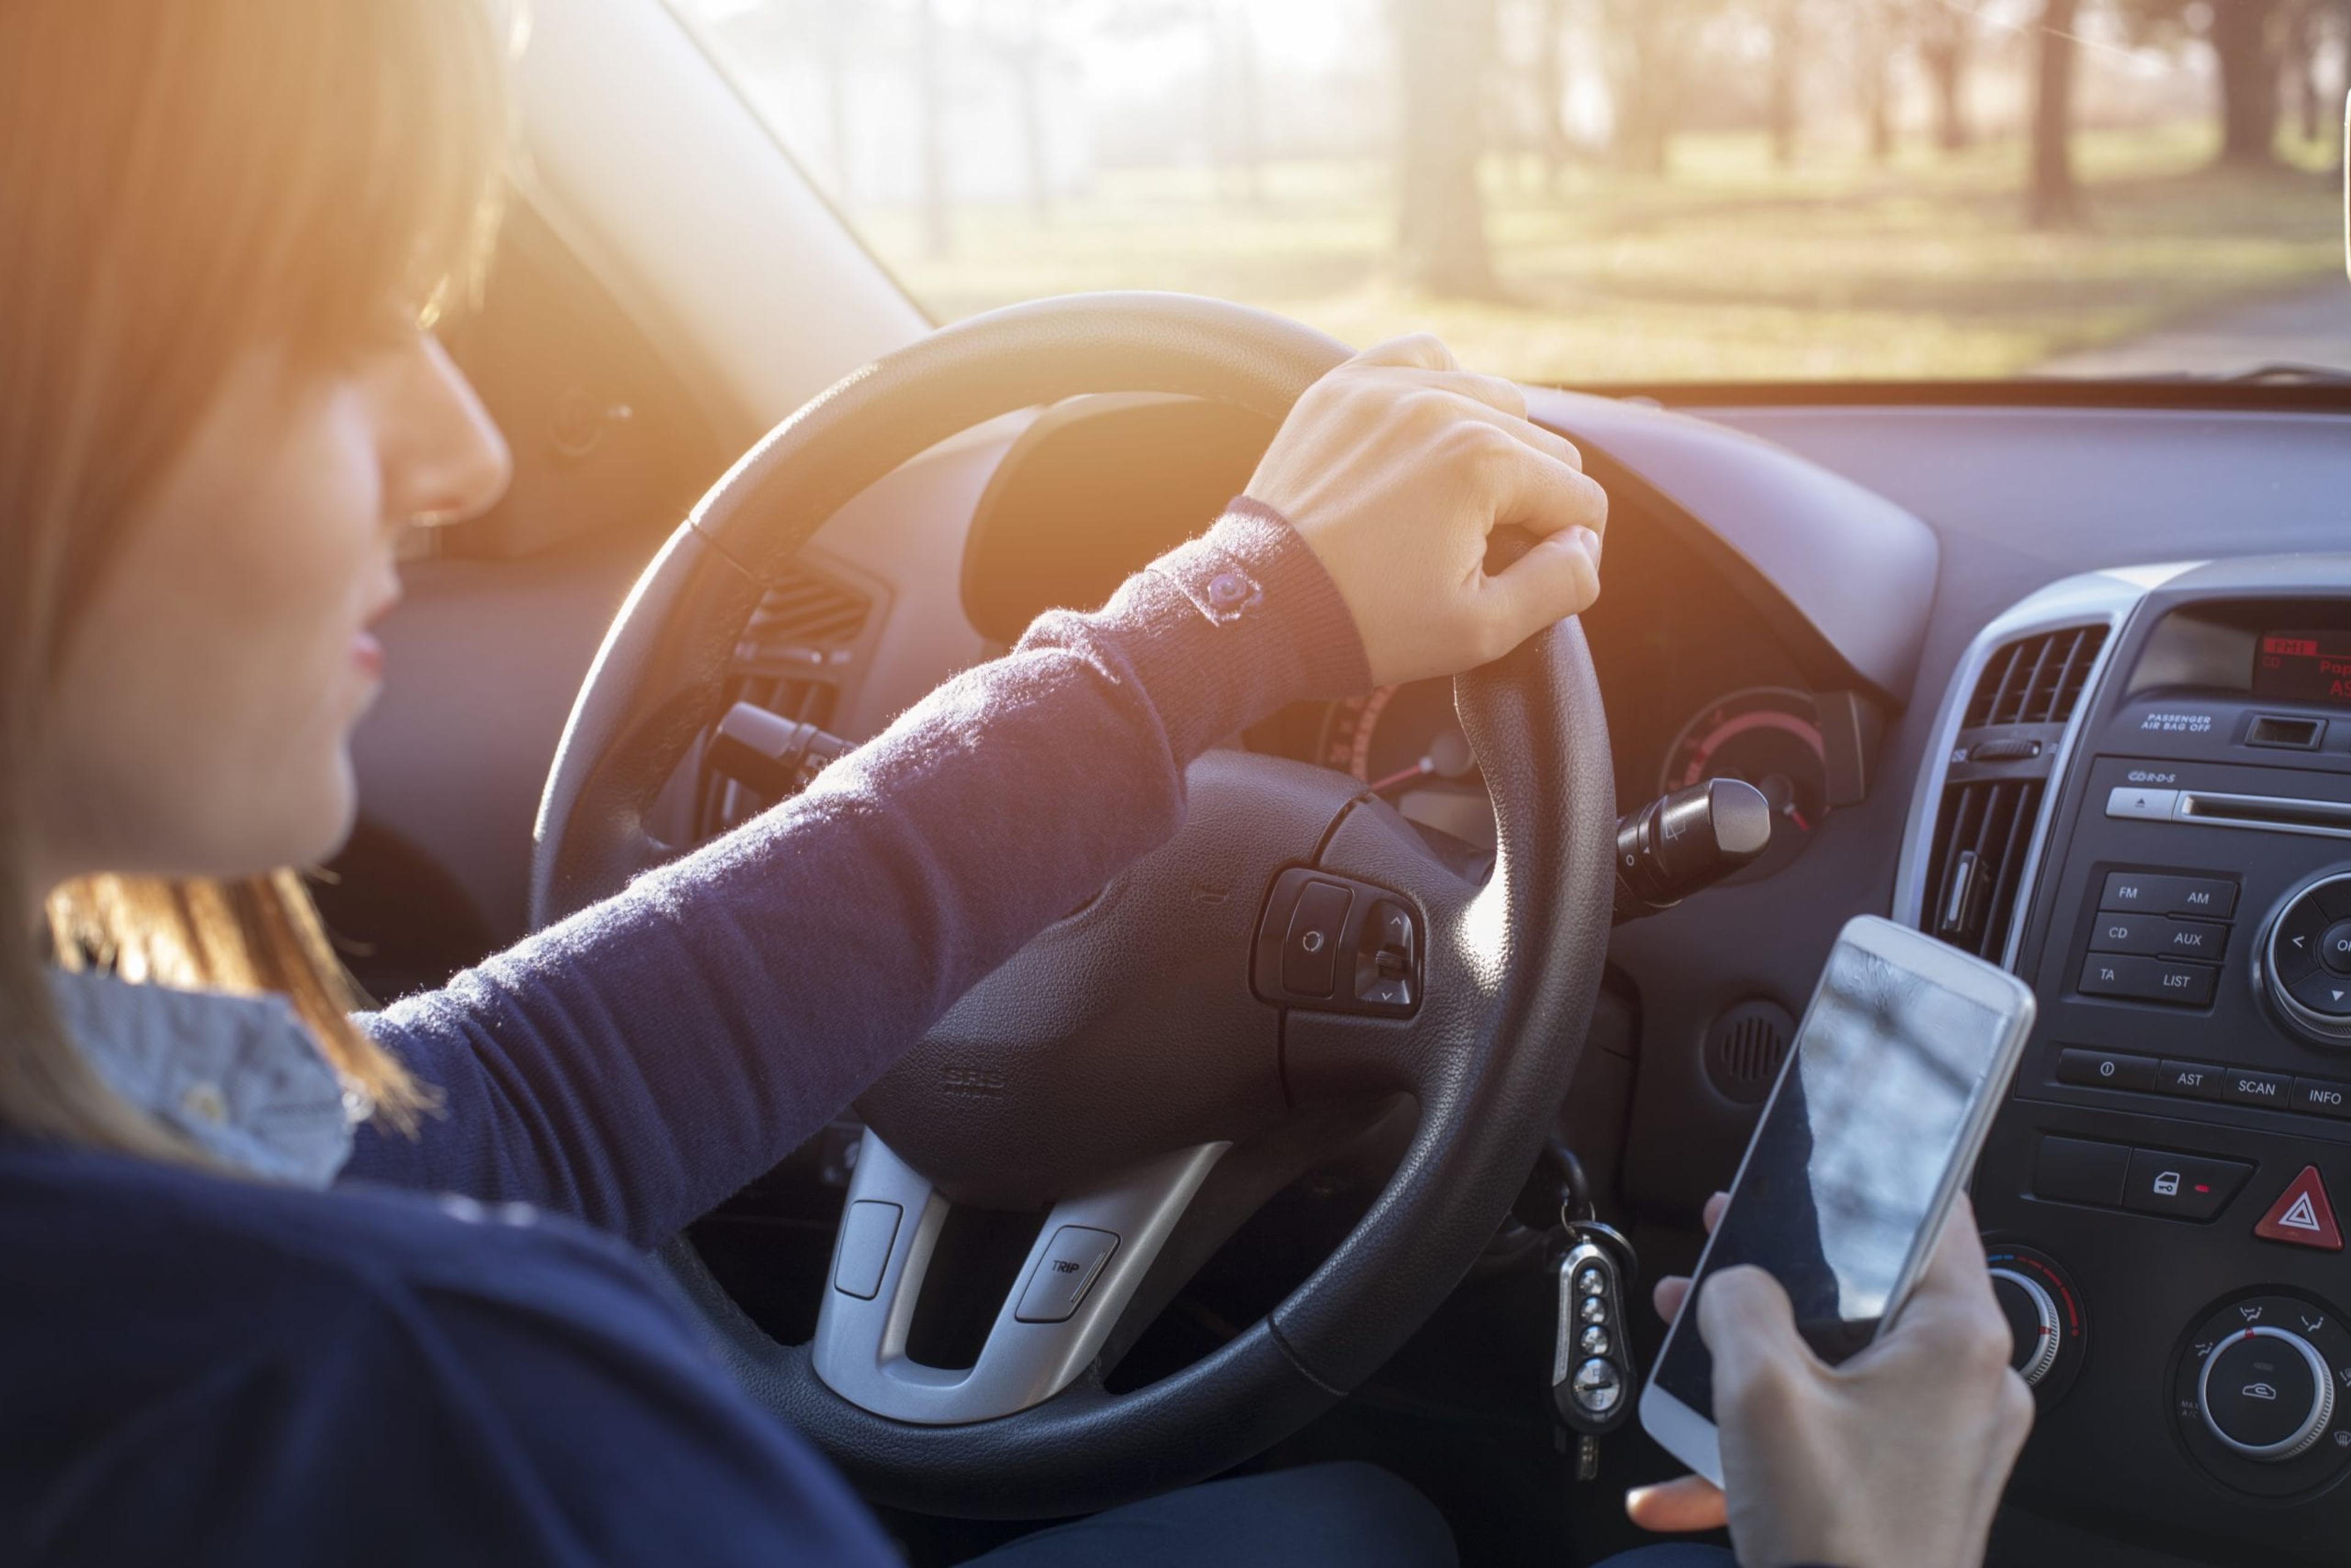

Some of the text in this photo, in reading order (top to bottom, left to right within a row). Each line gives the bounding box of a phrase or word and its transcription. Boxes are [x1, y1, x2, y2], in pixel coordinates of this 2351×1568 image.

[2141, 721, 2211, 732] AIR BAG OFF
[2147, 713, 2211, 724] PASSENGER
[2118, 887, 2210, 905] FM AM
[2108, 926, 2203, 946] CD AUX
[2101, 968, 2191, 988] TA LIST
[2177, 1072, 2342, 1105] AST SCAN INFO
[1052, 1259, 1080, 1274] TRIP
